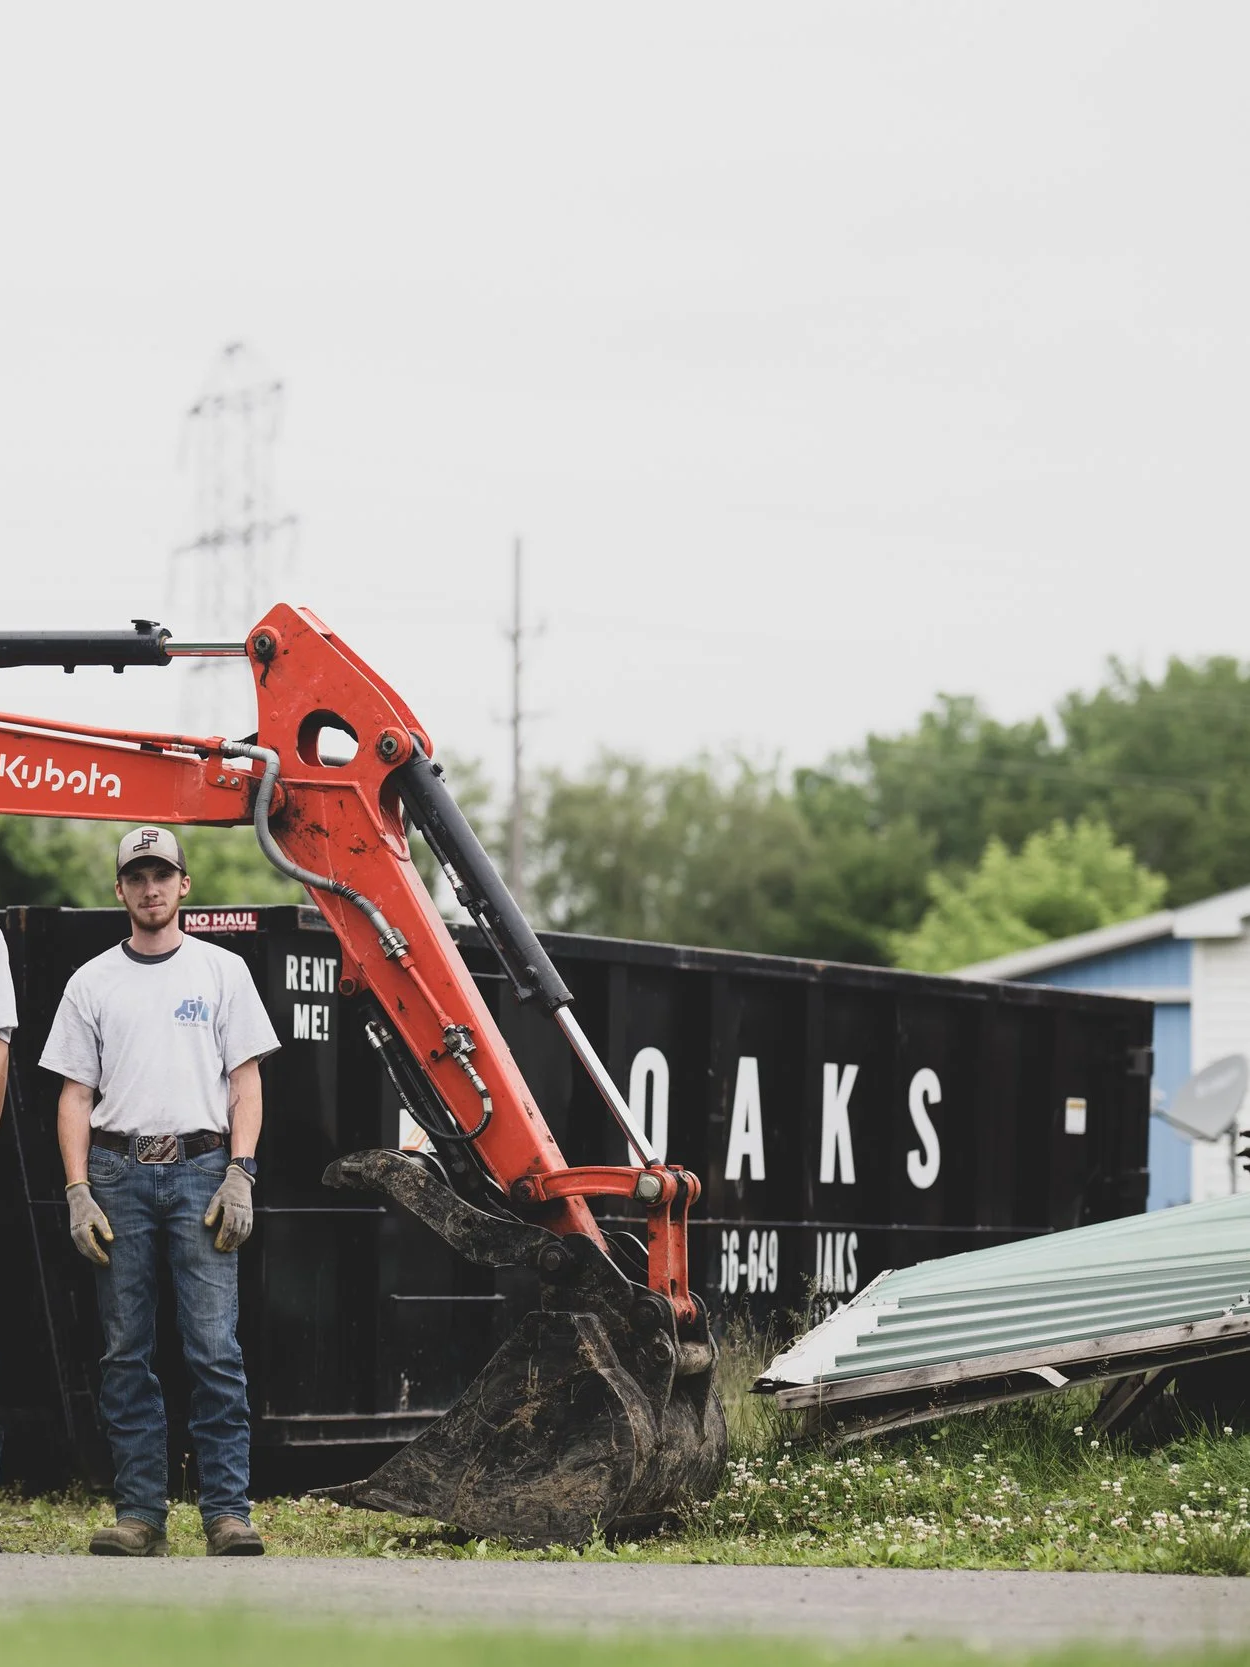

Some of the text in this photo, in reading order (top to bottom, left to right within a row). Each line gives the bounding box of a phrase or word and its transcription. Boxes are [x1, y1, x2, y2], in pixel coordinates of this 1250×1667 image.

[185, 912, 257, 926] NO HAUL
[286, 954, 337, 994] RENT
[293, 1003, 329, 1041] ME!
[628, 1047, 942, 1189] OAKS
